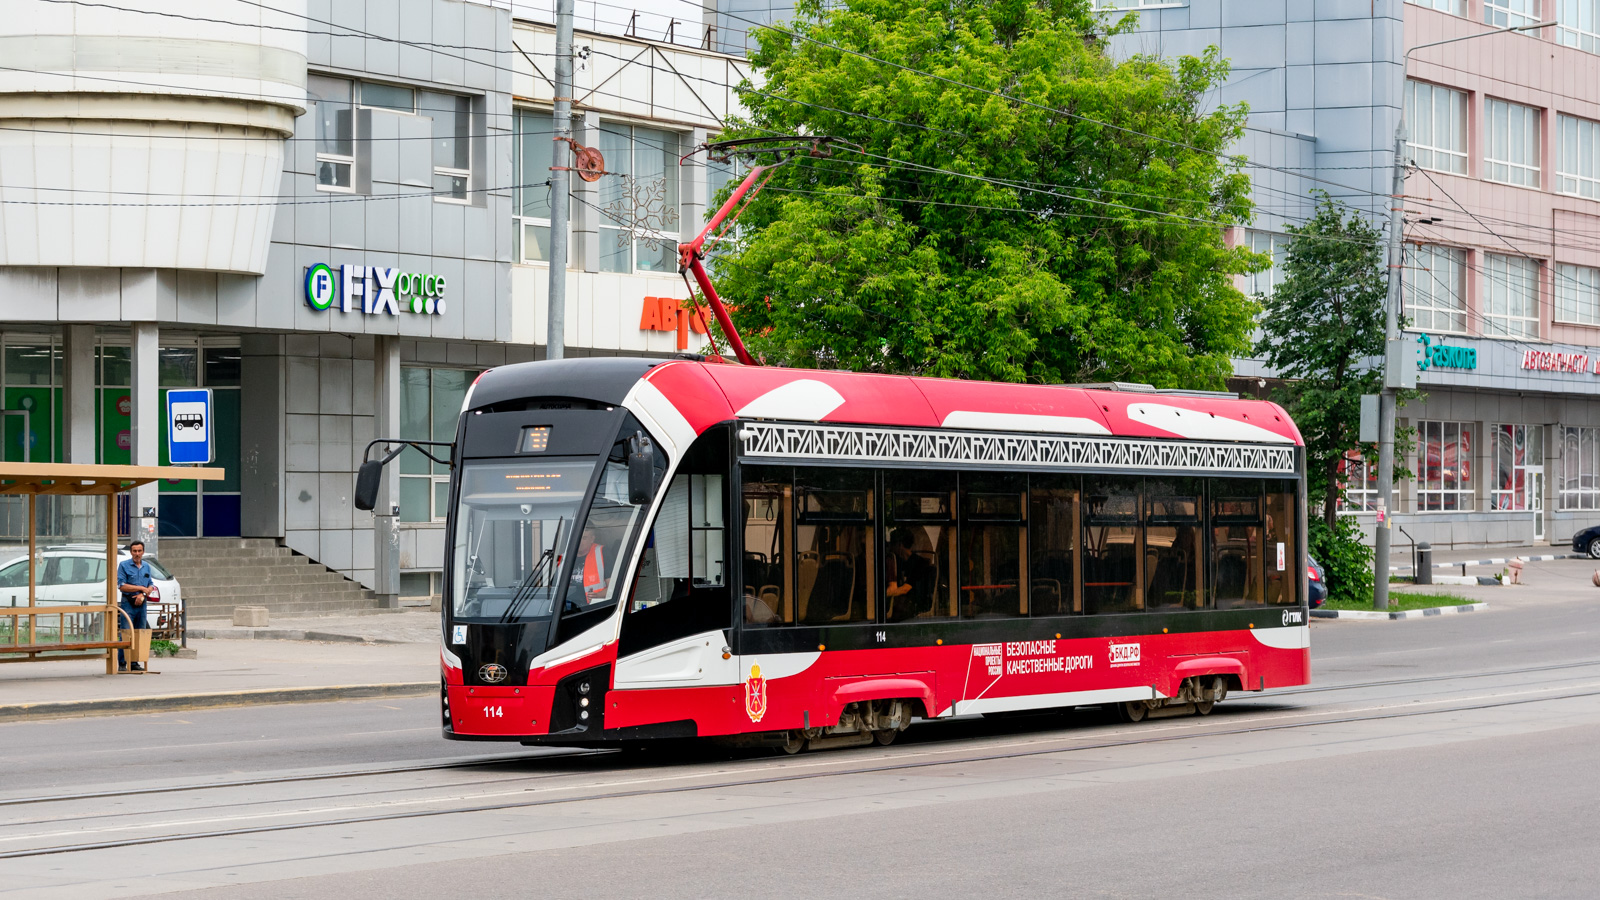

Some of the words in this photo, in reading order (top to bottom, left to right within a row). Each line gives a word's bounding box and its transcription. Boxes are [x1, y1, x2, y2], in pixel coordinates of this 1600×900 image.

[398, 271, 447, 300] price
[1432, 344, 1477, 369] askona
[1521, 349, 1589, 374] АВТОЗАПЧАСТИ
[876, 631, 886, 642] 114
[1006, 640, 1057, 657] БЕЗОПАСНЫЕ
[1115, 646, 1139, 660] БКД.РФ
[1006, 657, 1064, 675] КАЧЕСТВЕННЫЕ
[1065, 655, 1093, 673] ДОРОГИ
[483, 706, 503, 717] 114
